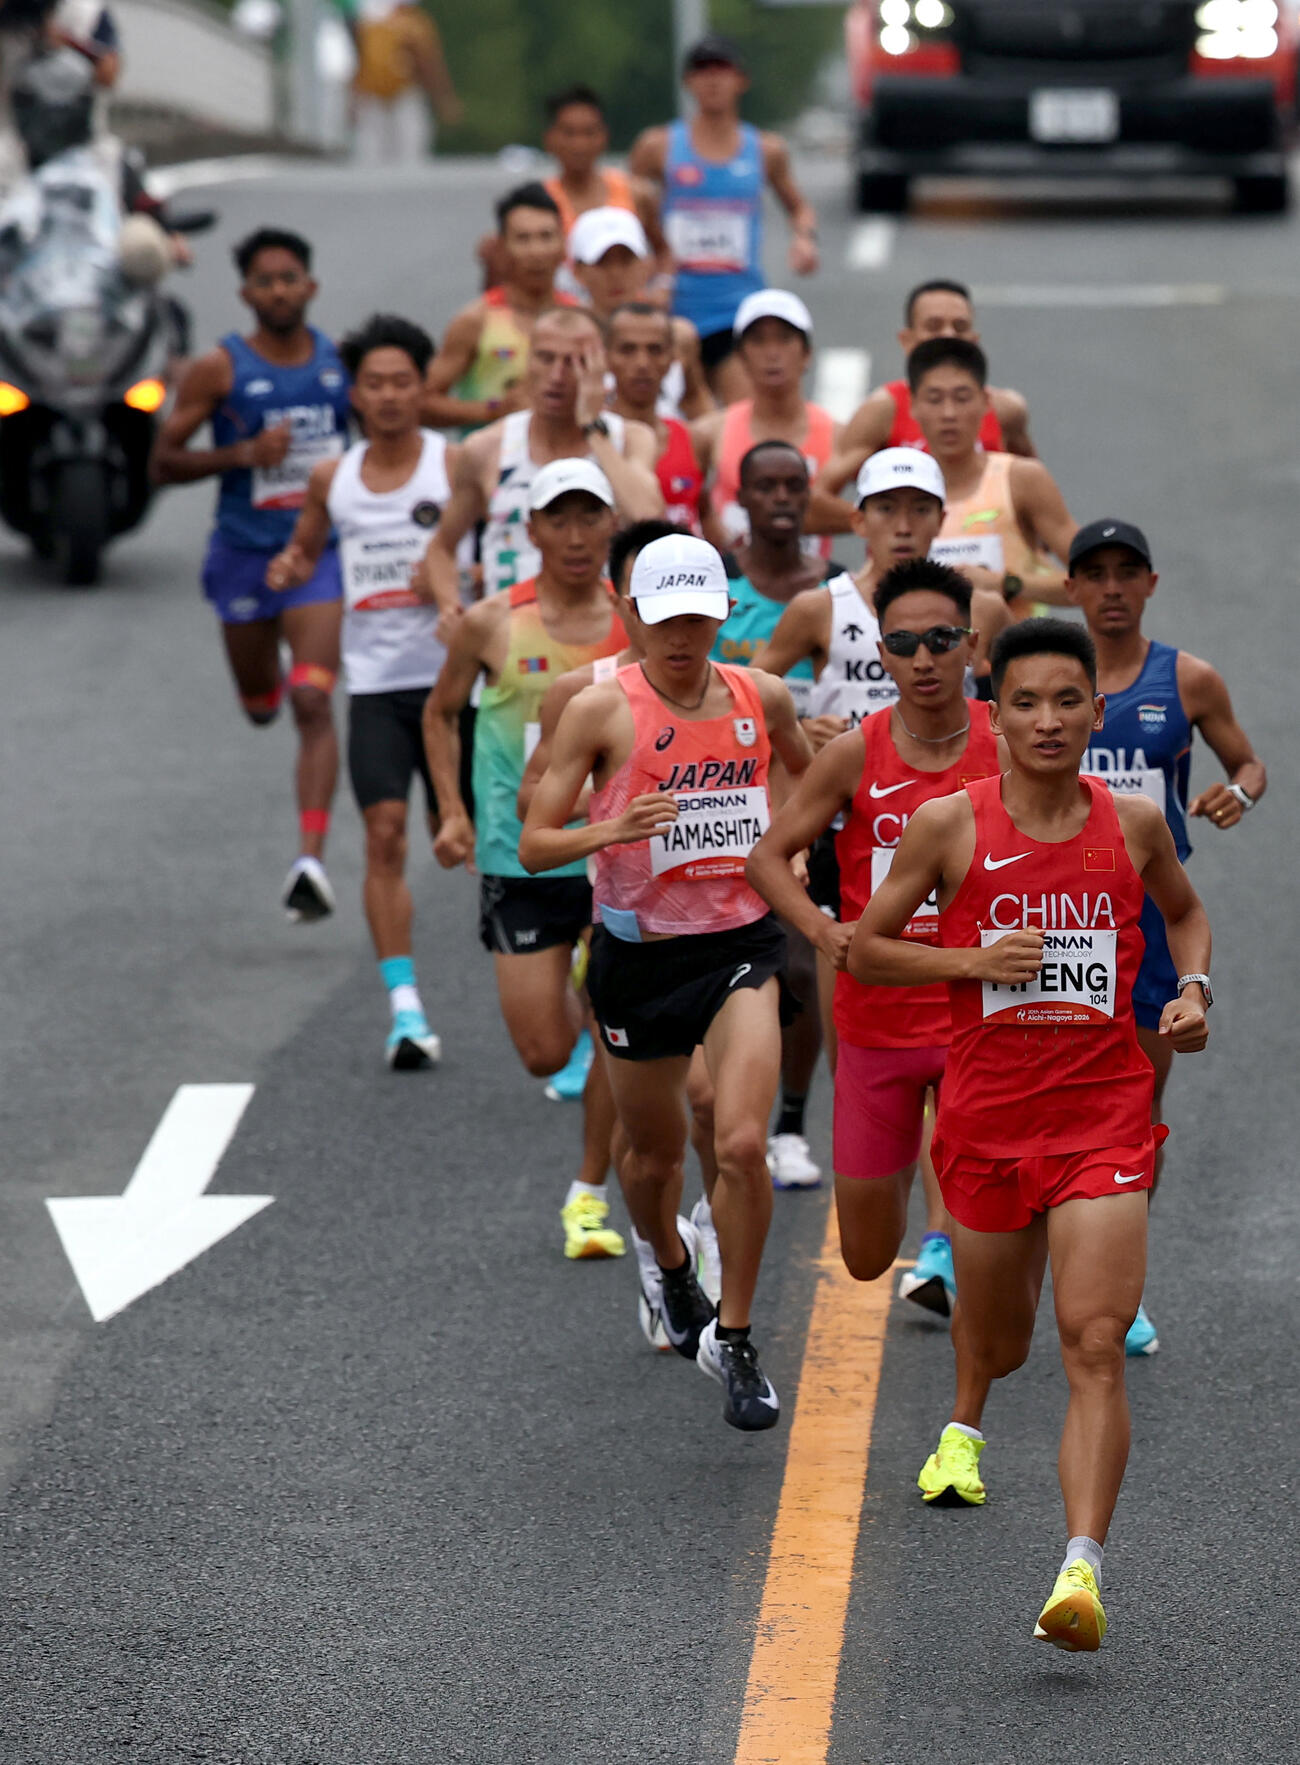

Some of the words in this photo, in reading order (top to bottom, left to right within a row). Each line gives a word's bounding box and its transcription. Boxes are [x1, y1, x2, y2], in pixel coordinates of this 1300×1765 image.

[656, 574, 707, 590] JAPAN
[1080, 748, 1149, 771] NDIA
[657, 758, 758, 791] JAPAN
[677, 794, 747, 811] BORNAN
[661, 817, 762, 852] YAMASHITA
[990, 892, 1116, 930] CHINA
[1043, 935, 1093, 949] RNAN
[1044, 950, 1093, 959] TECHNOLOGY
[991, 962, 1108, 993] .ENG
[1089, 994, 1108, 1005] 104
[1027, 1014, 1073, 1022] Aichi-Nagoya
